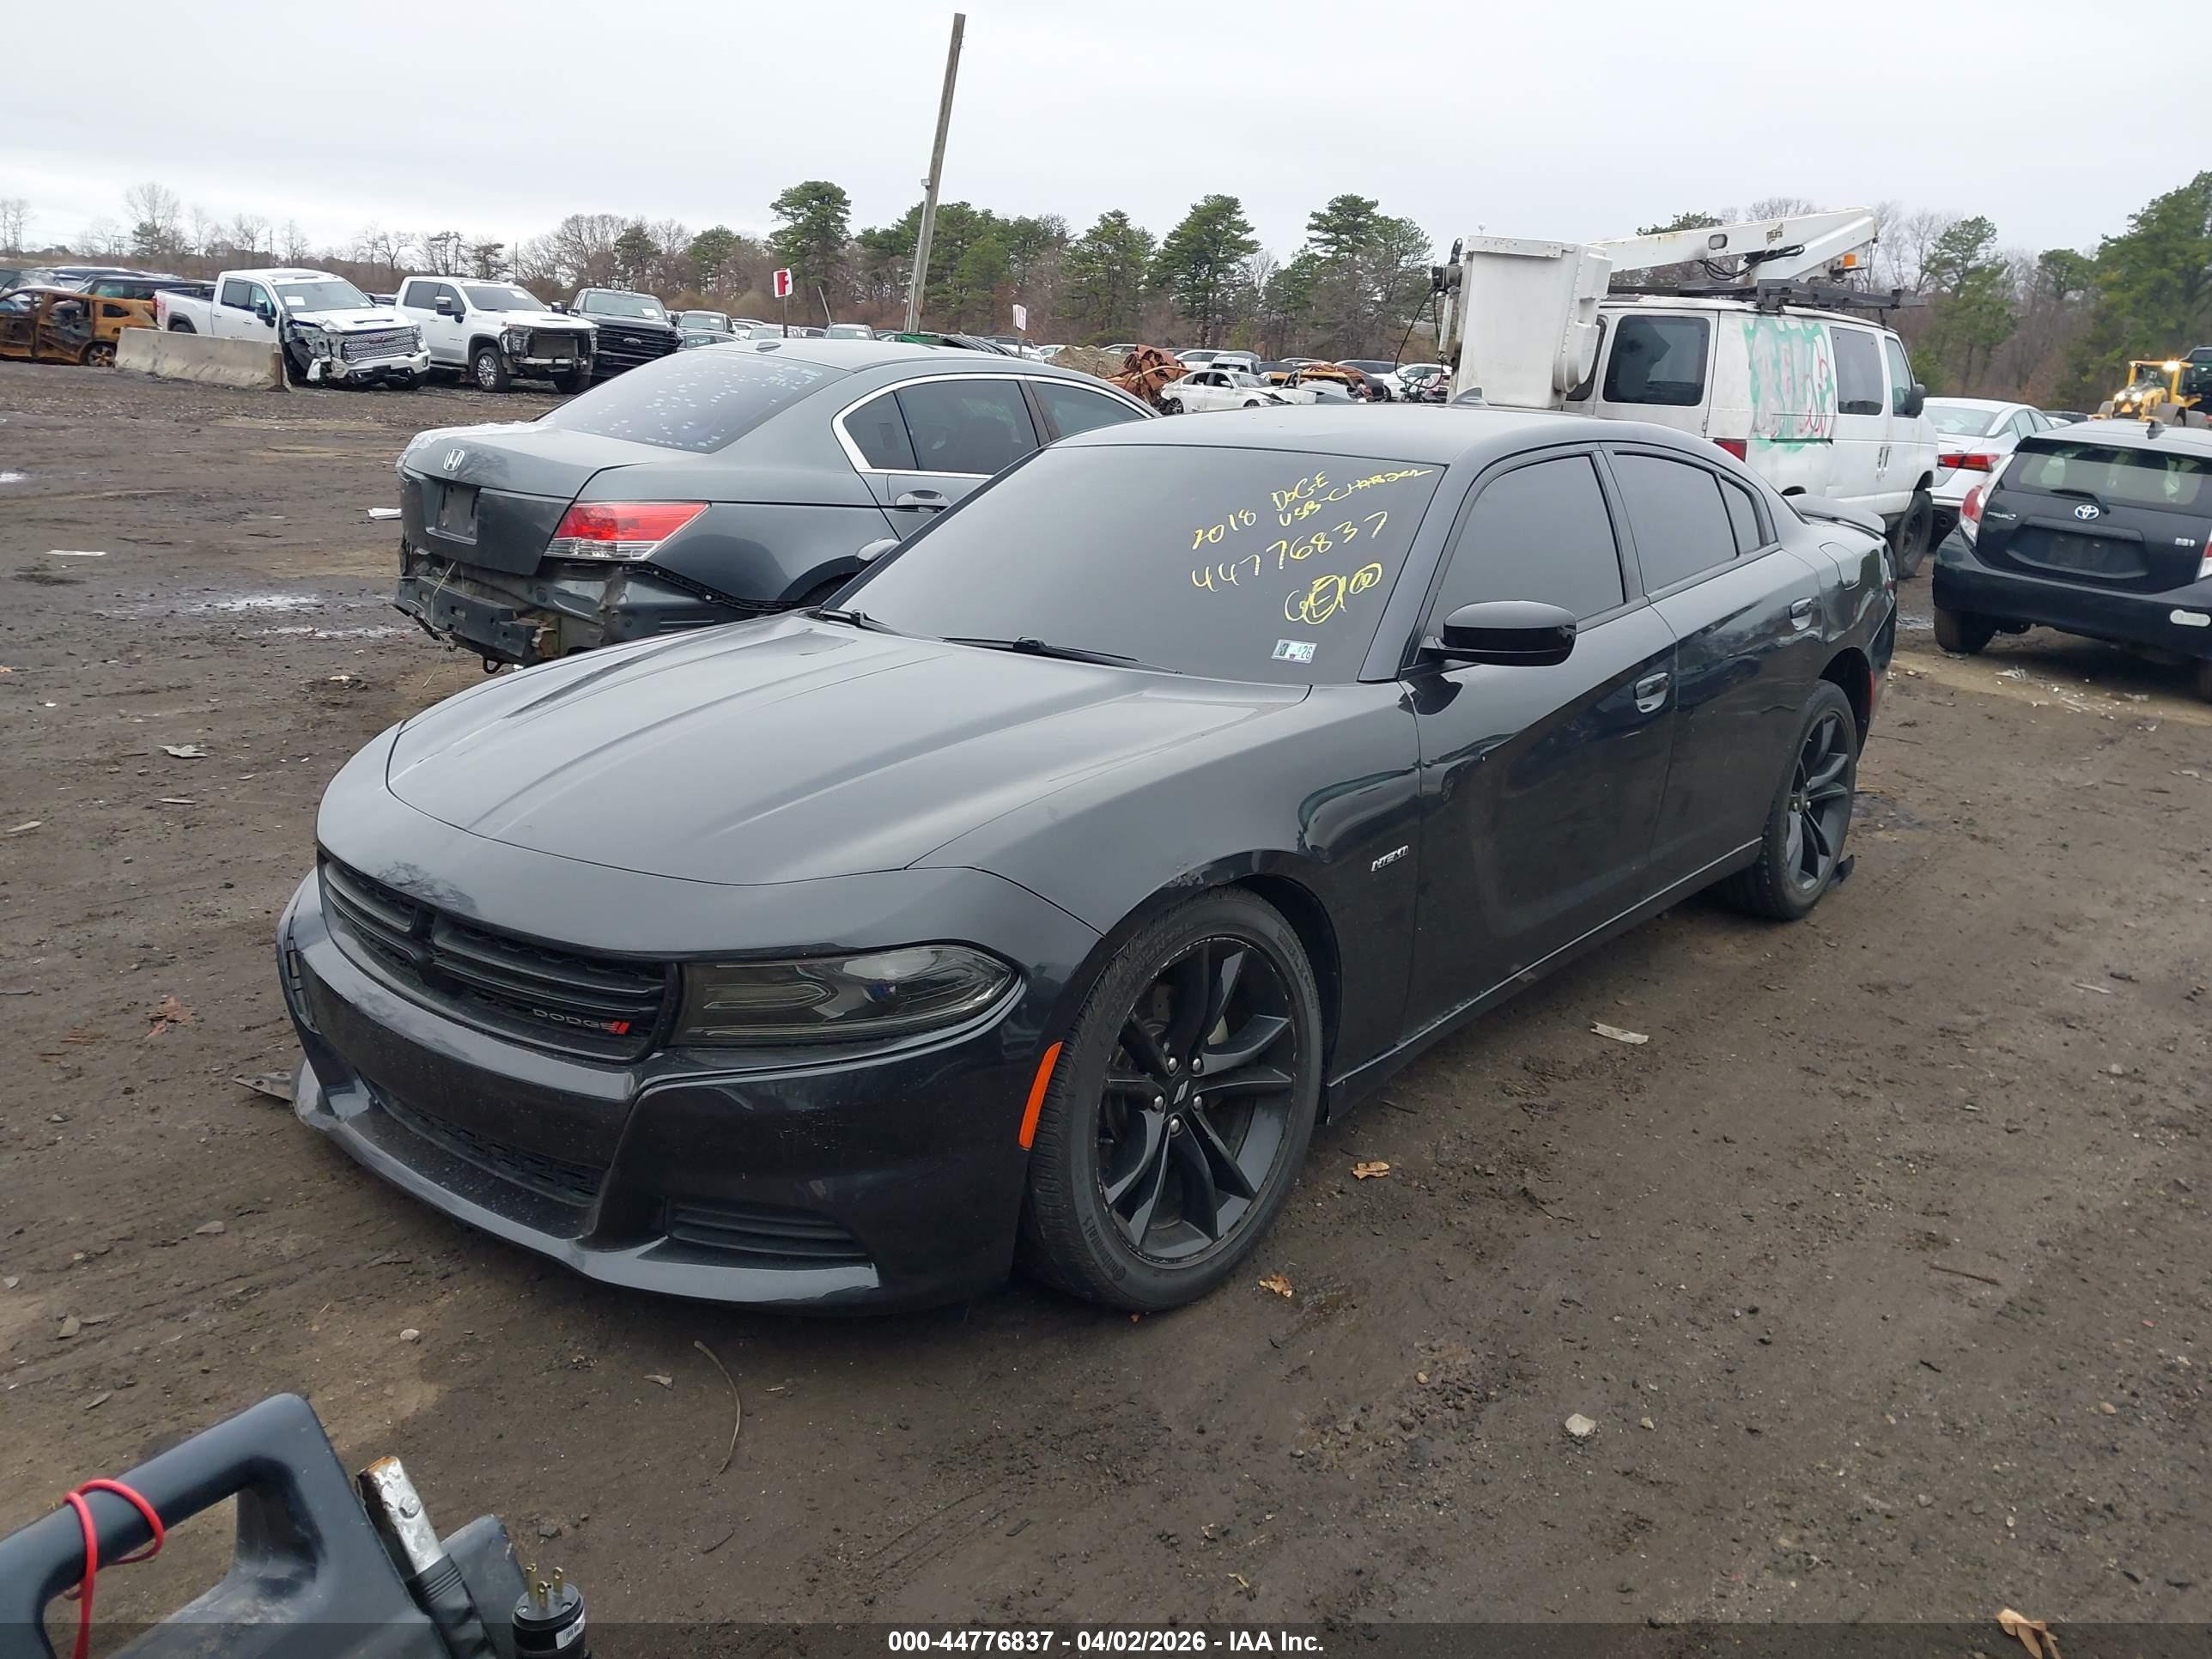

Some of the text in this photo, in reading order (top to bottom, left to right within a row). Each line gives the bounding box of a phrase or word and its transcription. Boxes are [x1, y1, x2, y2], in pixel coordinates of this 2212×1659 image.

[776, 270, 790, 296] F
[1191, 508, 1256, 550] 2018
[1191, 511, 1389, 592] 44776837
[532, 1008, 616, 1032] DODGE
